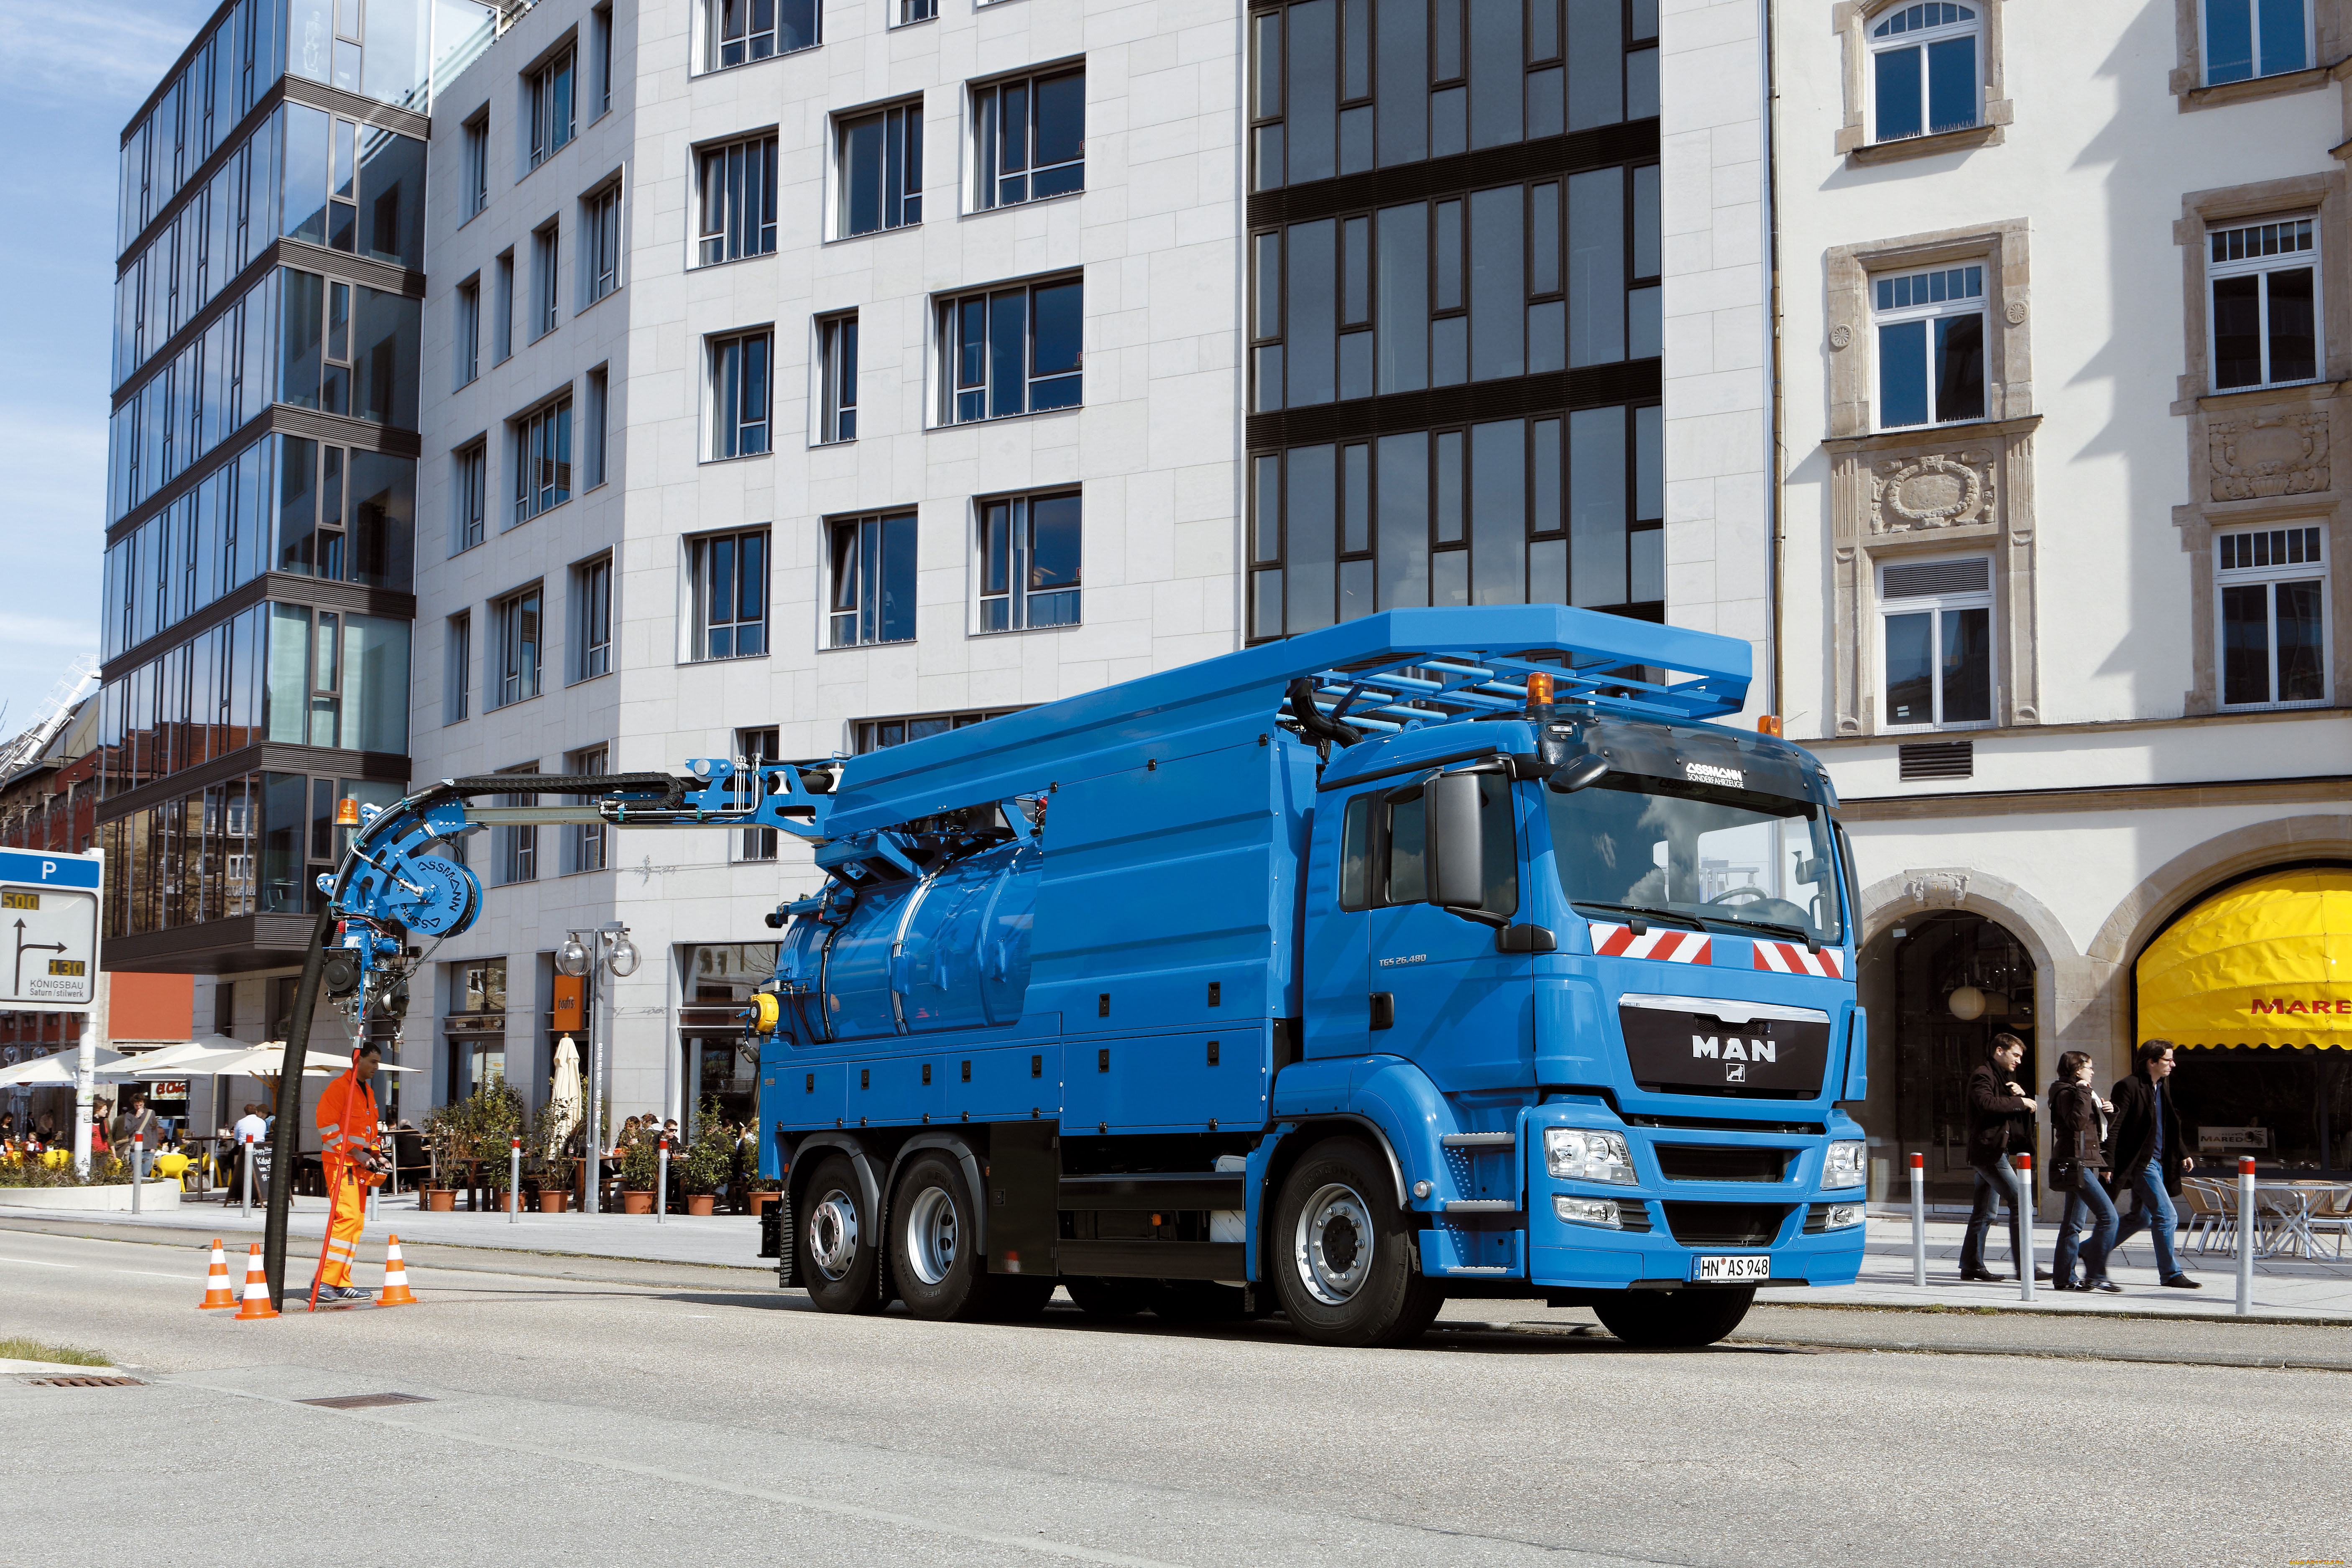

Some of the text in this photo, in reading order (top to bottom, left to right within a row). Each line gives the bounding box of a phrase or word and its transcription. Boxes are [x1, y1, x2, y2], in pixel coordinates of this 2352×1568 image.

[1686, 762, 1743, 781] ASSMANN
[1687, 773, 1744, 789] SONDERFAHRZEUGE
[42, 861, 56, 879] P
[418, 861, 462, 912] ASSMANN
[3, 893, 37, 910] 500
[49, 960, 83, 976] 130
[1379, 954, 1426, 967] TGS 26.480
[30, 978, 83, 989] KÖNIGSBAU
[2251, 999, 2352, 1014] MARE
[1692, 1034, 1775, 1062] MAN
[1701, 1259, 1768, 1277] HN AS 948
